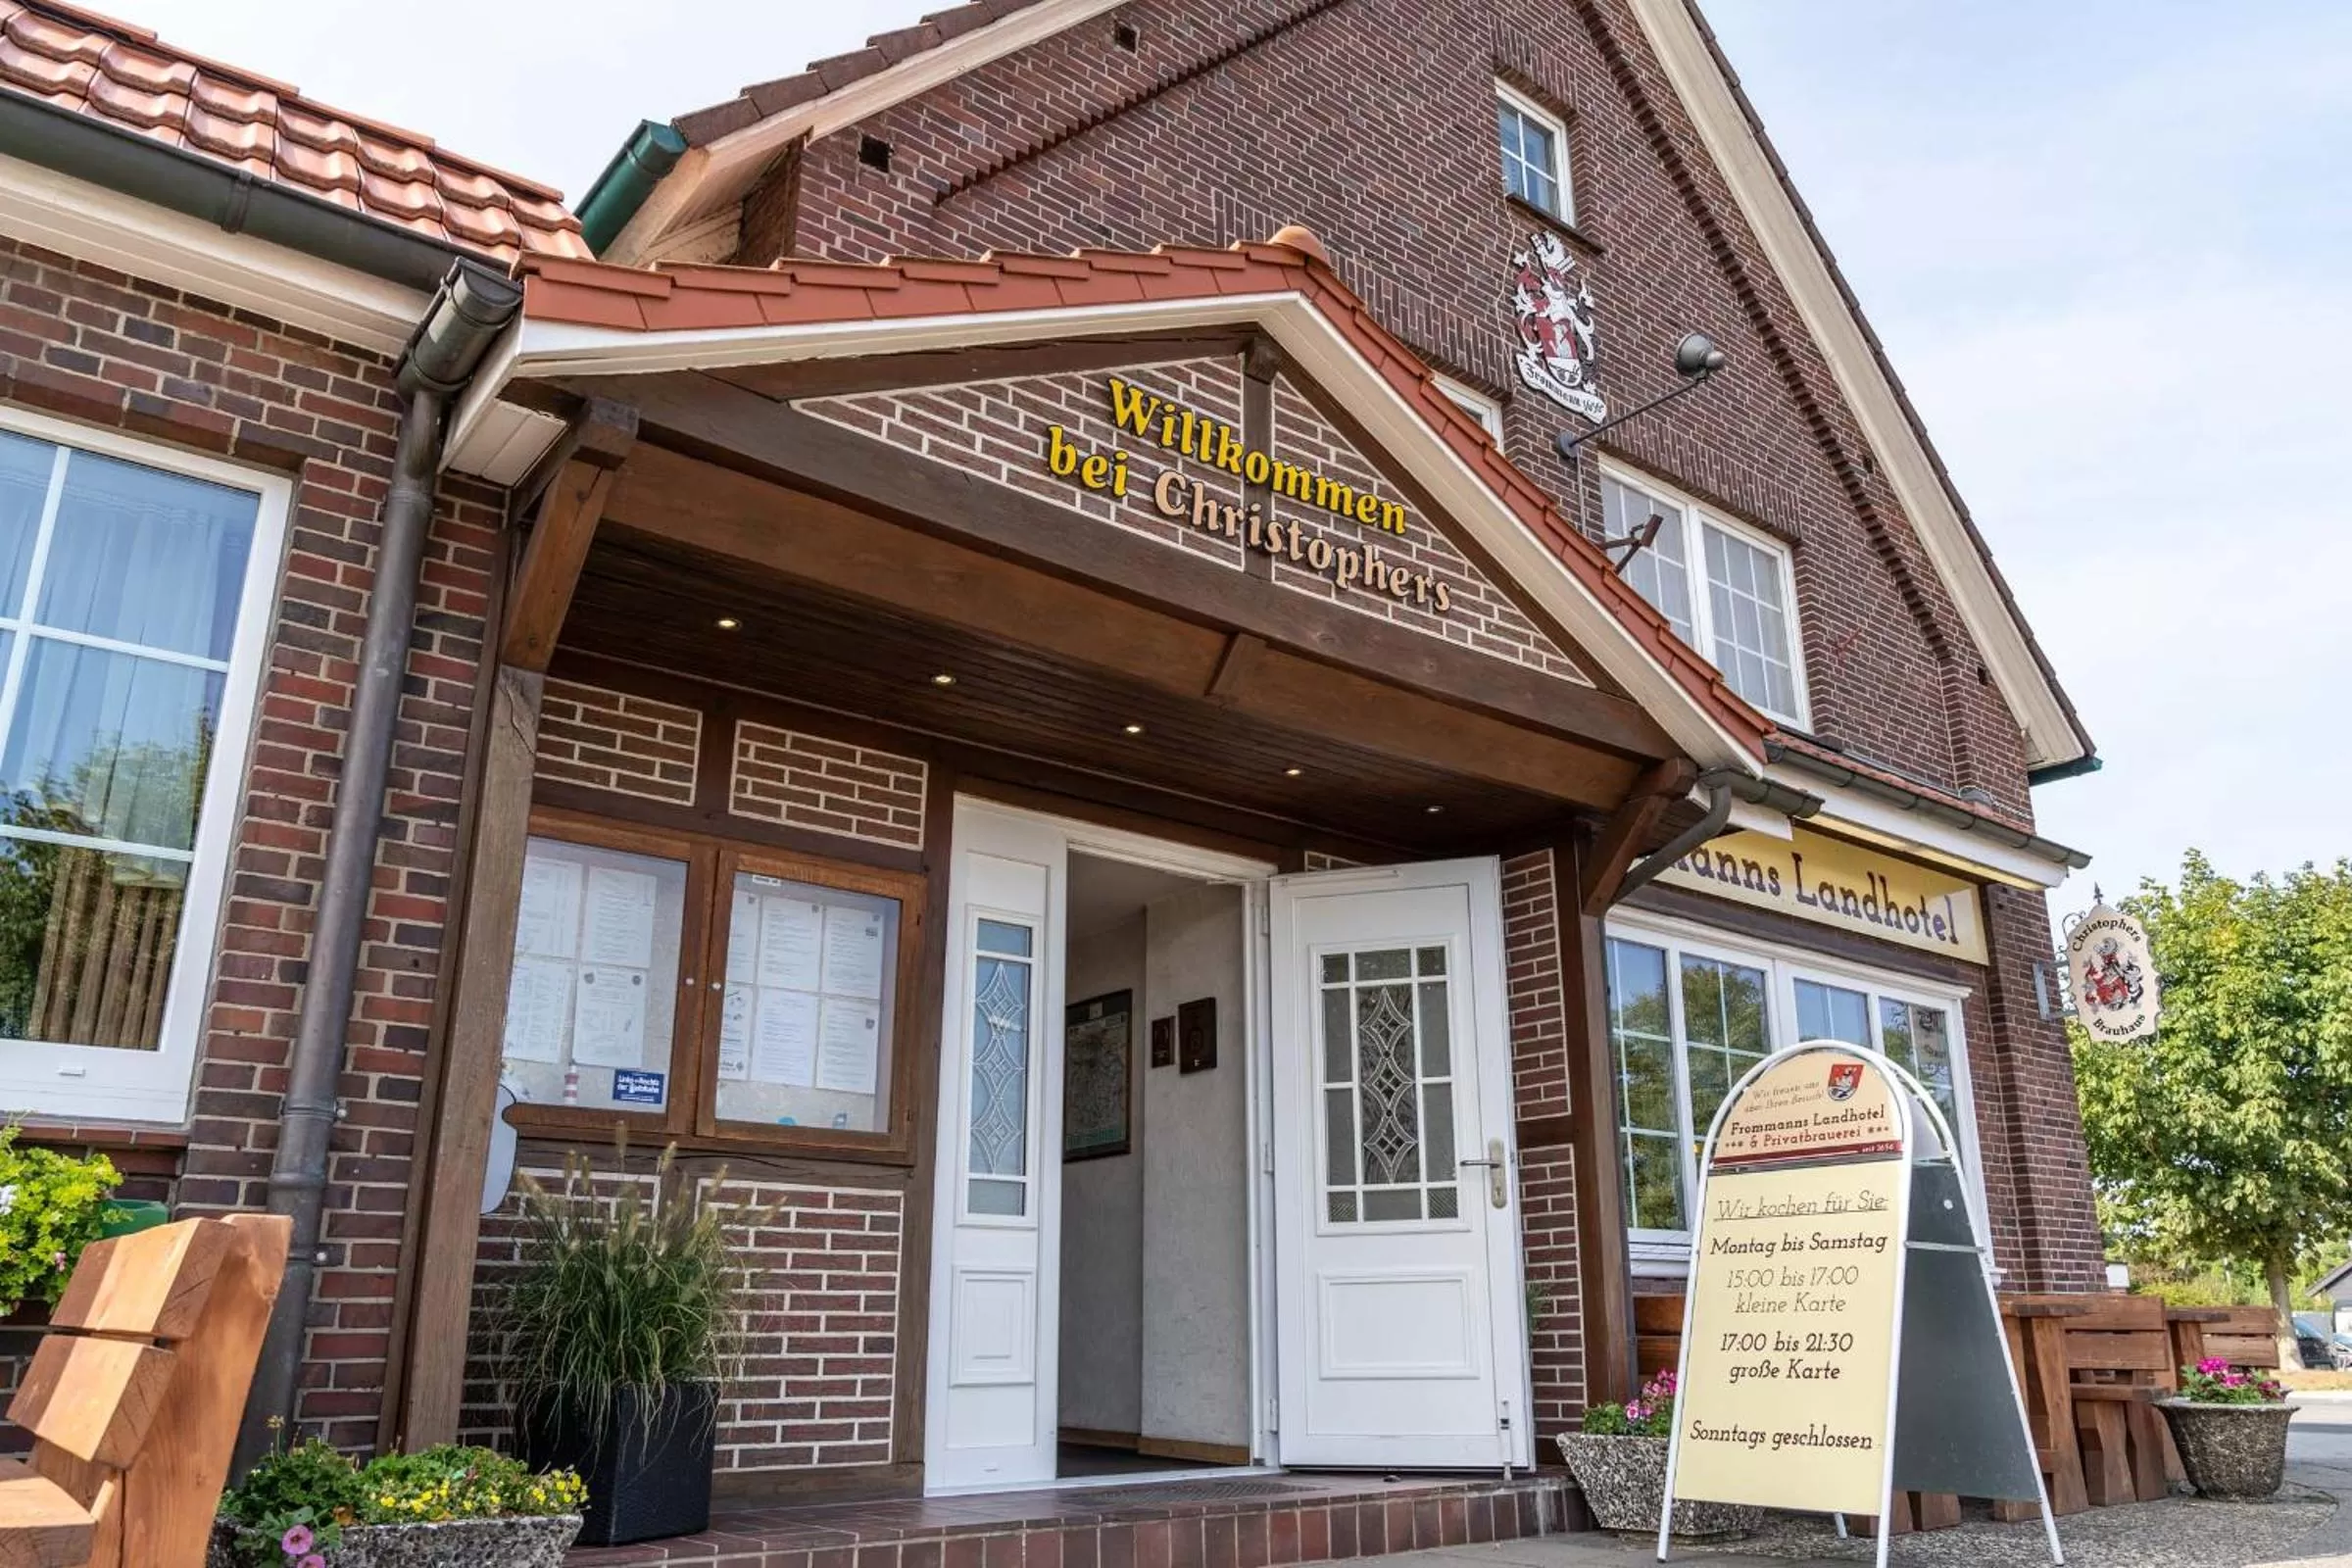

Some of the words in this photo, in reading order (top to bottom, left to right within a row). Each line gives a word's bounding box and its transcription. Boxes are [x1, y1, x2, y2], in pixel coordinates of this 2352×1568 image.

[1109, 378, 1406, 534] Willkommen
[1049, 425, 1128, 497] bei
[1154, 471, 1450, 612] Christophers
[1668, 847, 1782, 898] anns
[1791, 852, 1959, 946] Landhotel
[2072, 917, 2142, 953] Christophers
[2092, 1013, 2146, 1036] Brauhaus
[1731, 1119, 1809, 1136] Frommanns
[1813, 1104, 1885, 1126] Landhotel
[1764, 1126, 1861, 1147] Privatbrauerei
[1717, 1200, 1749, 1218] Wir
[1757, 1194, 1818, 1216] kochen
[1825, 1192, 1852, 1212] für
[1858, 1190, 1887, 1210] Sie
[1710, 1238, 1777, 1258] Montag
[1781, 1233, 1804, 1251] bis
[1809, 1232, 1887, 1253] Samstag
[1727, 1268, 1775, 1289] 15:00
[1780, 1266, 1804, 1286] bis
[1810, 1265, 1859, 1287] 17:00
[1735, 1293, 1788, 1314] kleine
[1793, 1292, 1847, 1313] Karte
[1720, 1333, 1767, 1351] 17:00
[1773, 1331, 1800, 1351] bis
[1805, 1333, 1854, 1352] 21:30
[1730, 1359, 1781, 1384] große
[1786, 1358, 1841, 1380] Karte
[1690, 1420, 1766, 1449] Sonntags
[1772, 1423, 1874, 1451] geschlossen
